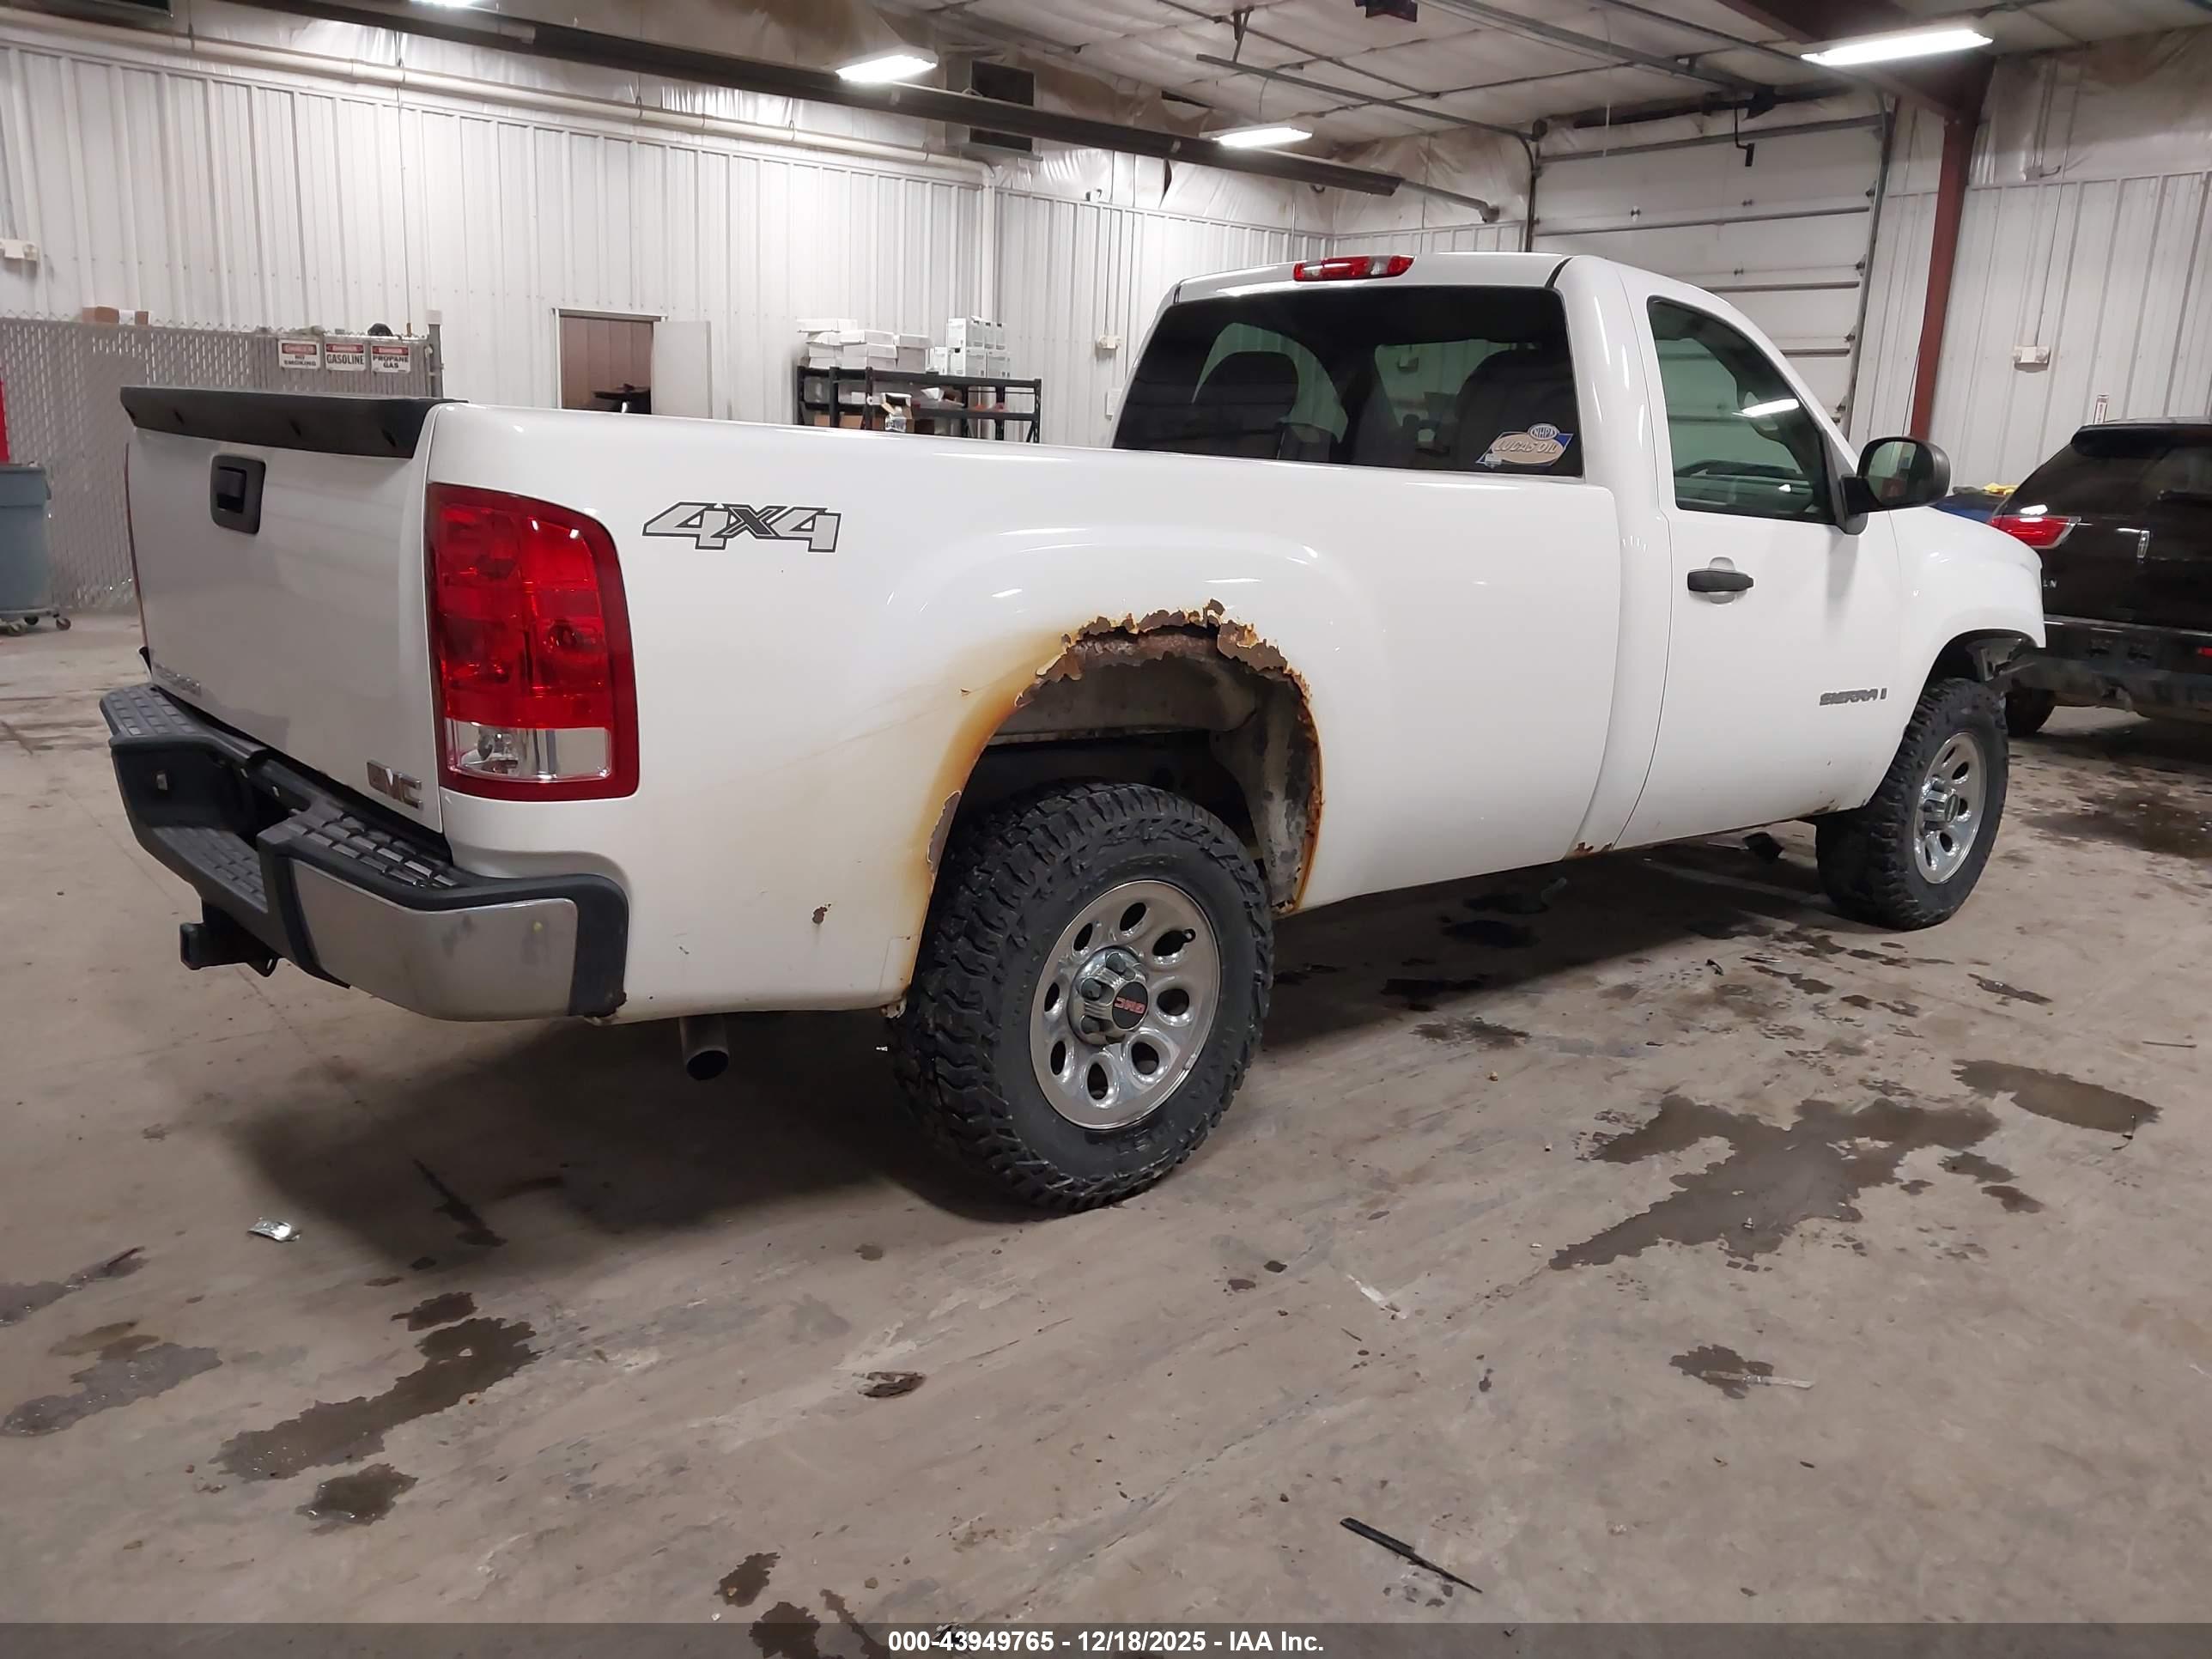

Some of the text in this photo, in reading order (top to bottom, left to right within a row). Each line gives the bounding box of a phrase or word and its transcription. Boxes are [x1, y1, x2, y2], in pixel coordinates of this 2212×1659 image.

[326, 354, 364, 365] GASOLINE
[1494, 441, 1558, 453] LUCAS OIL
[367, 760, 424, 810] GMC
[1115, 996, 1146, 1015] GMC
